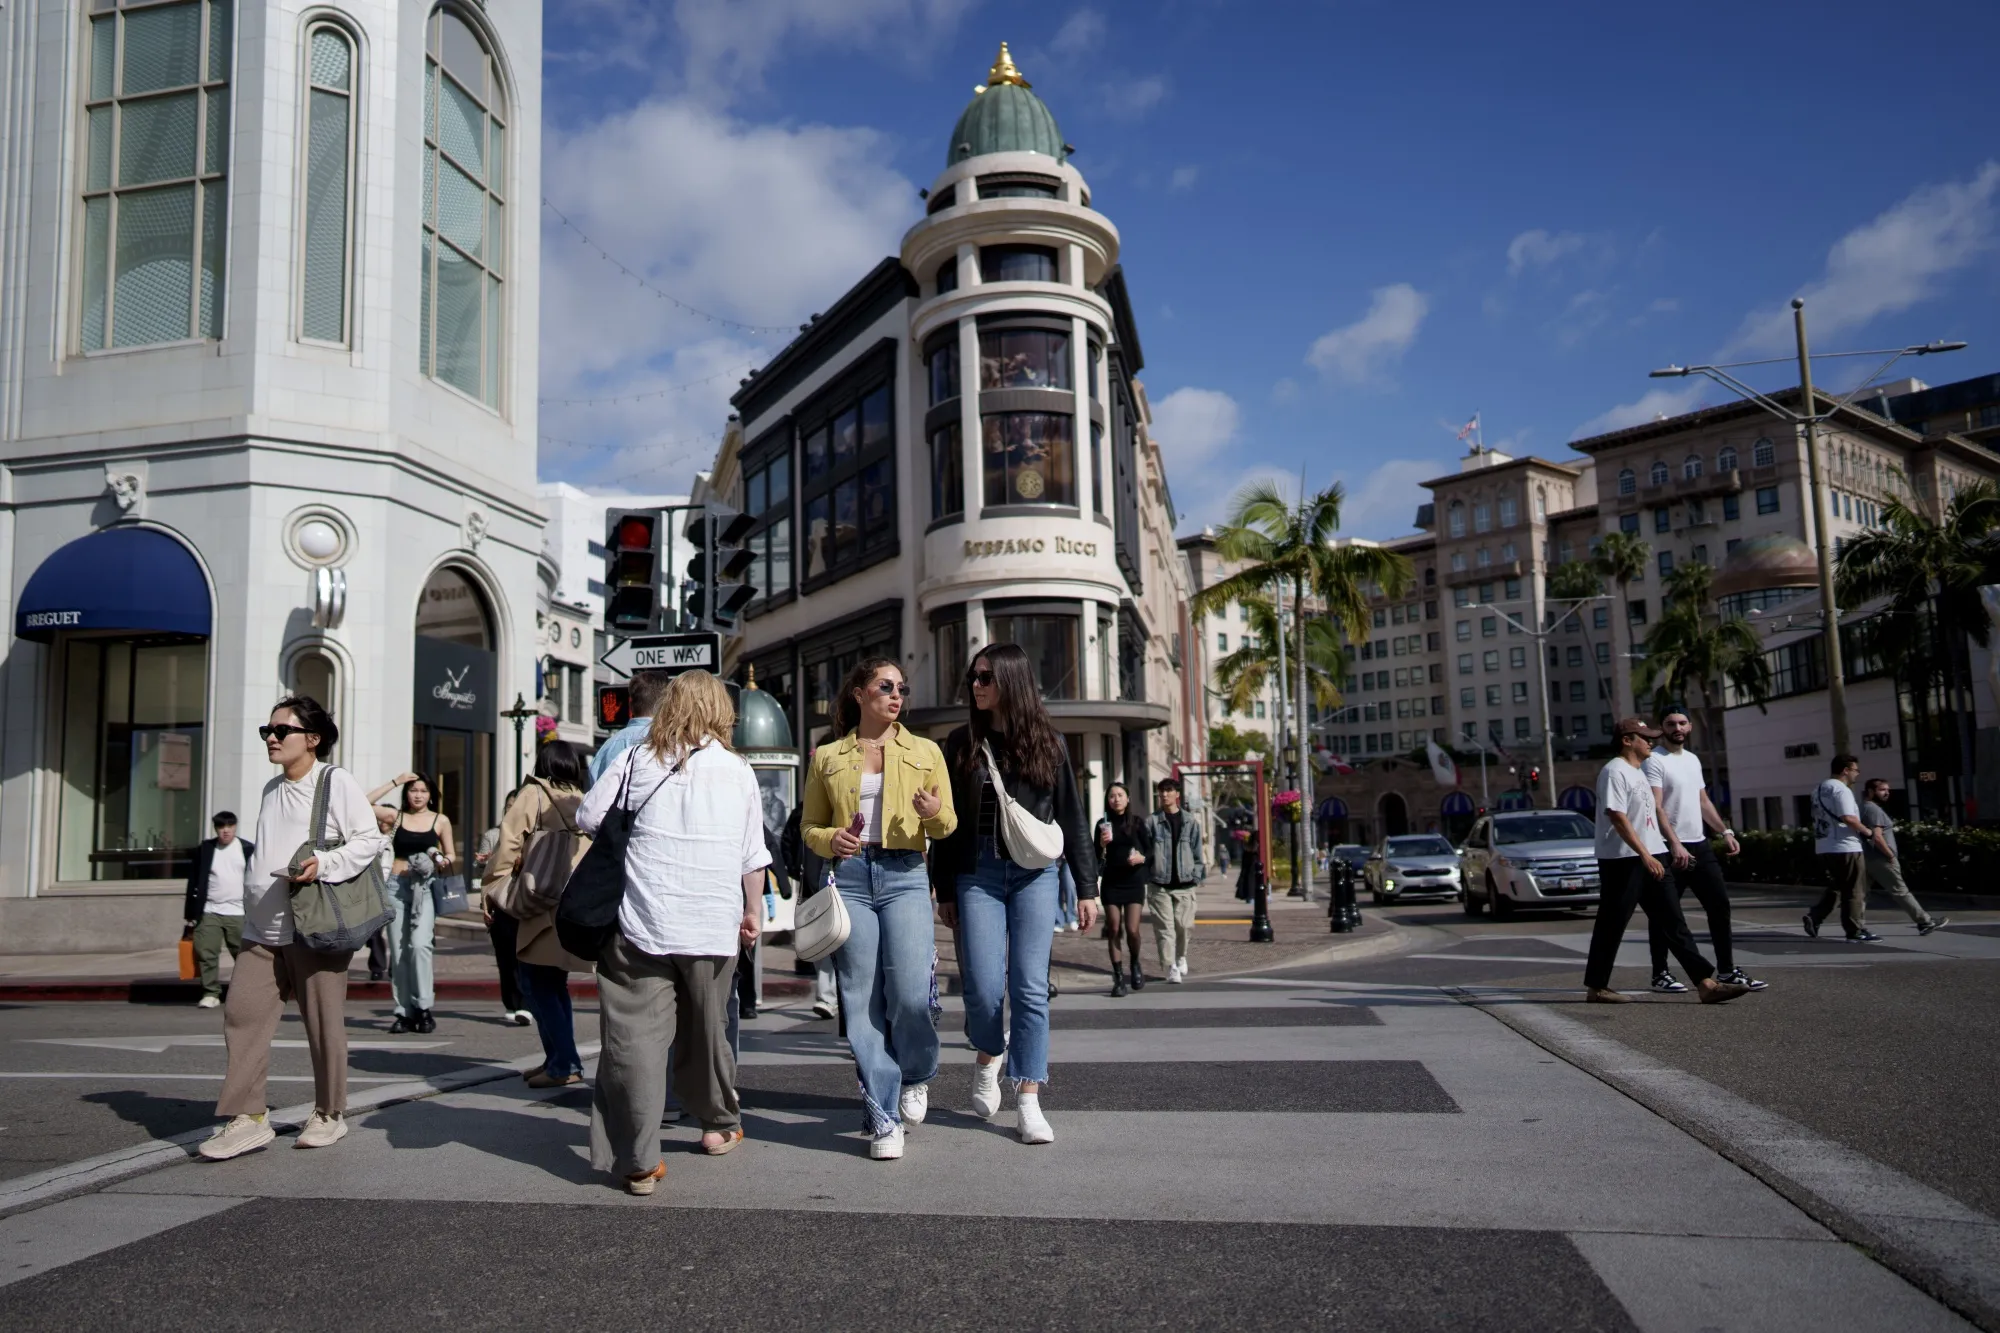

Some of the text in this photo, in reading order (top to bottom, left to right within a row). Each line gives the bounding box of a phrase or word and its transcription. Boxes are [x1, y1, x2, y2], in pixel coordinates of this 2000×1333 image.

[964, 536, 1097, 558] STEFANO RICCI
[26, 610, 82, 627] BREGUET
[635, 647, 704, 665] ONE WAY
[432, 681, 477, 709] Breguet
[1862, 732, 1892, 751] FENDI
[1919, 771, 1936, 781] FENDI
